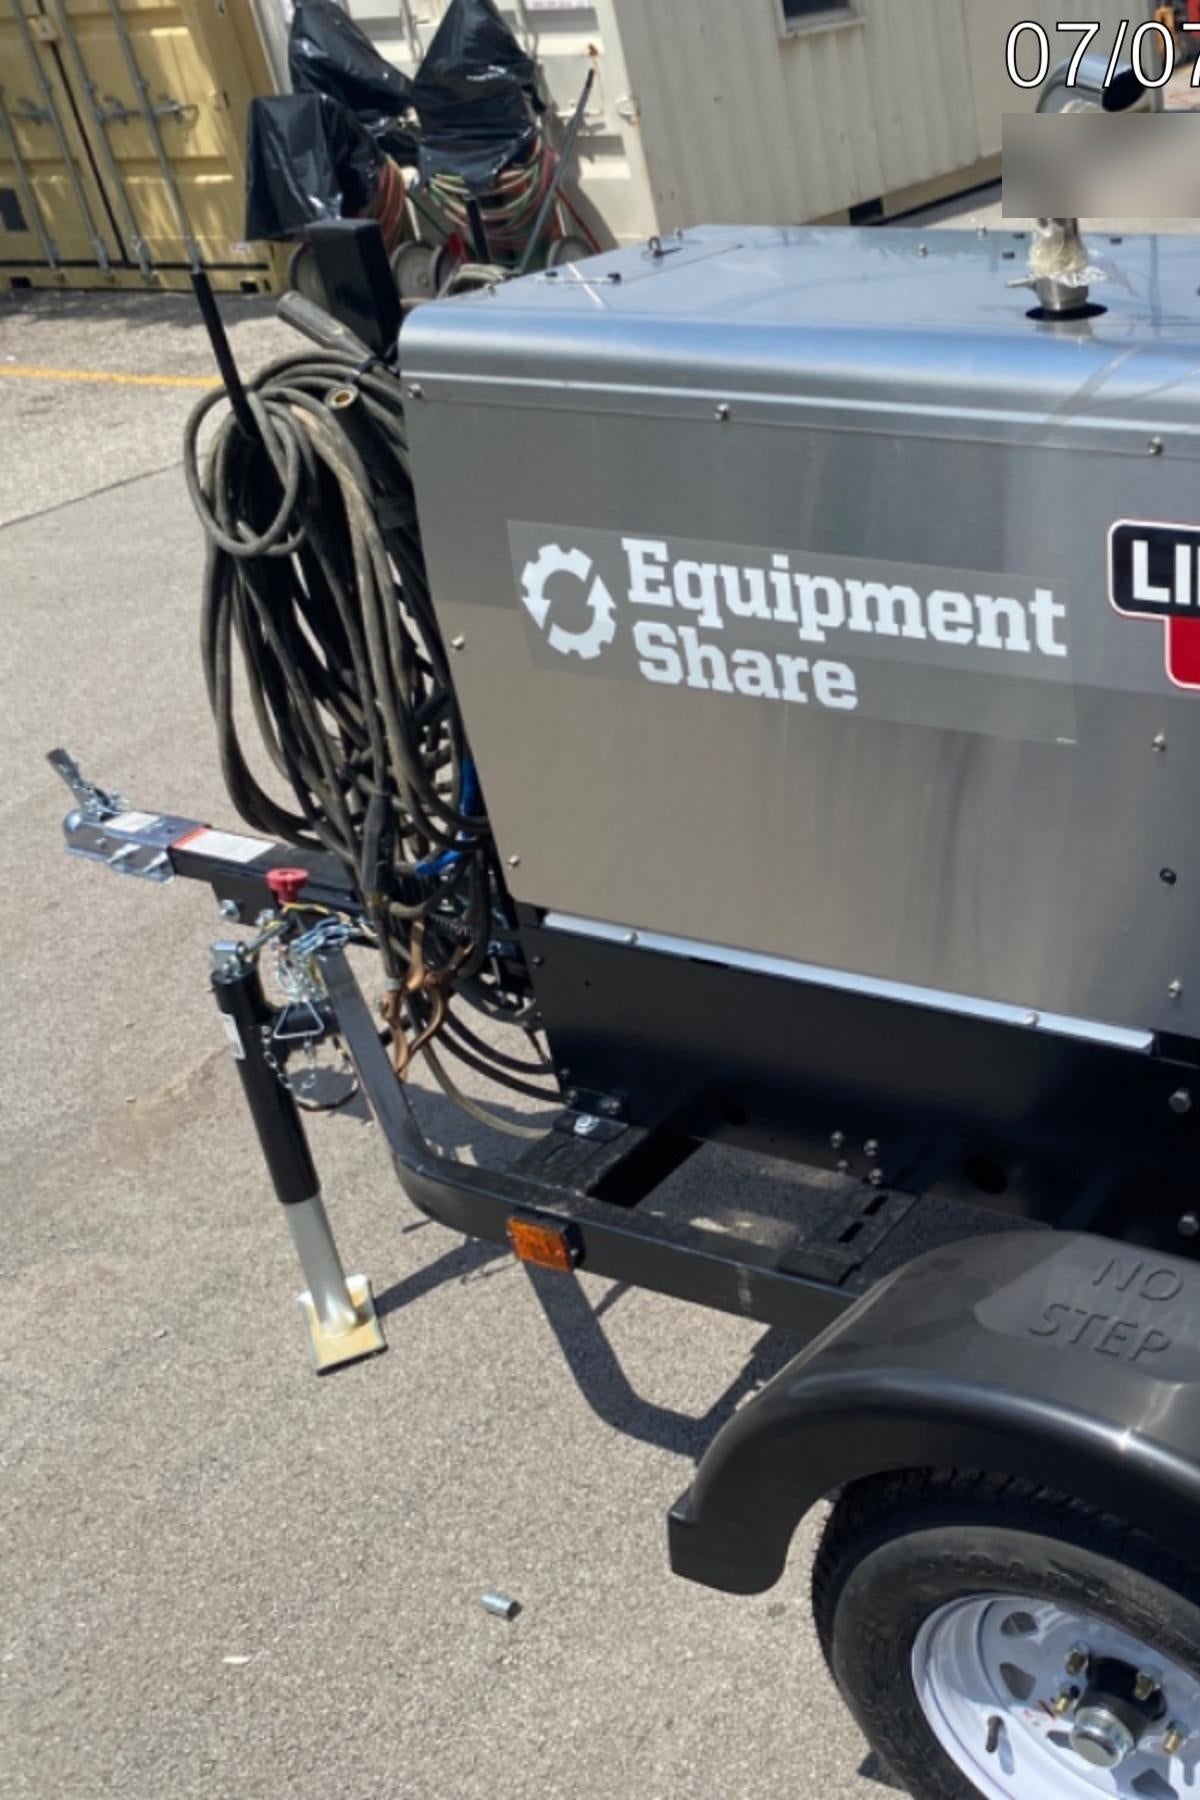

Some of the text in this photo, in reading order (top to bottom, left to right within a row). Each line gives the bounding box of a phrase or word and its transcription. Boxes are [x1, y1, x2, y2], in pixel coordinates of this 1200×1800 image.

[621, 537, 1068, 657] Equipment
[632, 620, 859, 711] Share
[1091, 1257, 1185, 1303] NO
[1027, 1302, 1173, 1363] STEP
